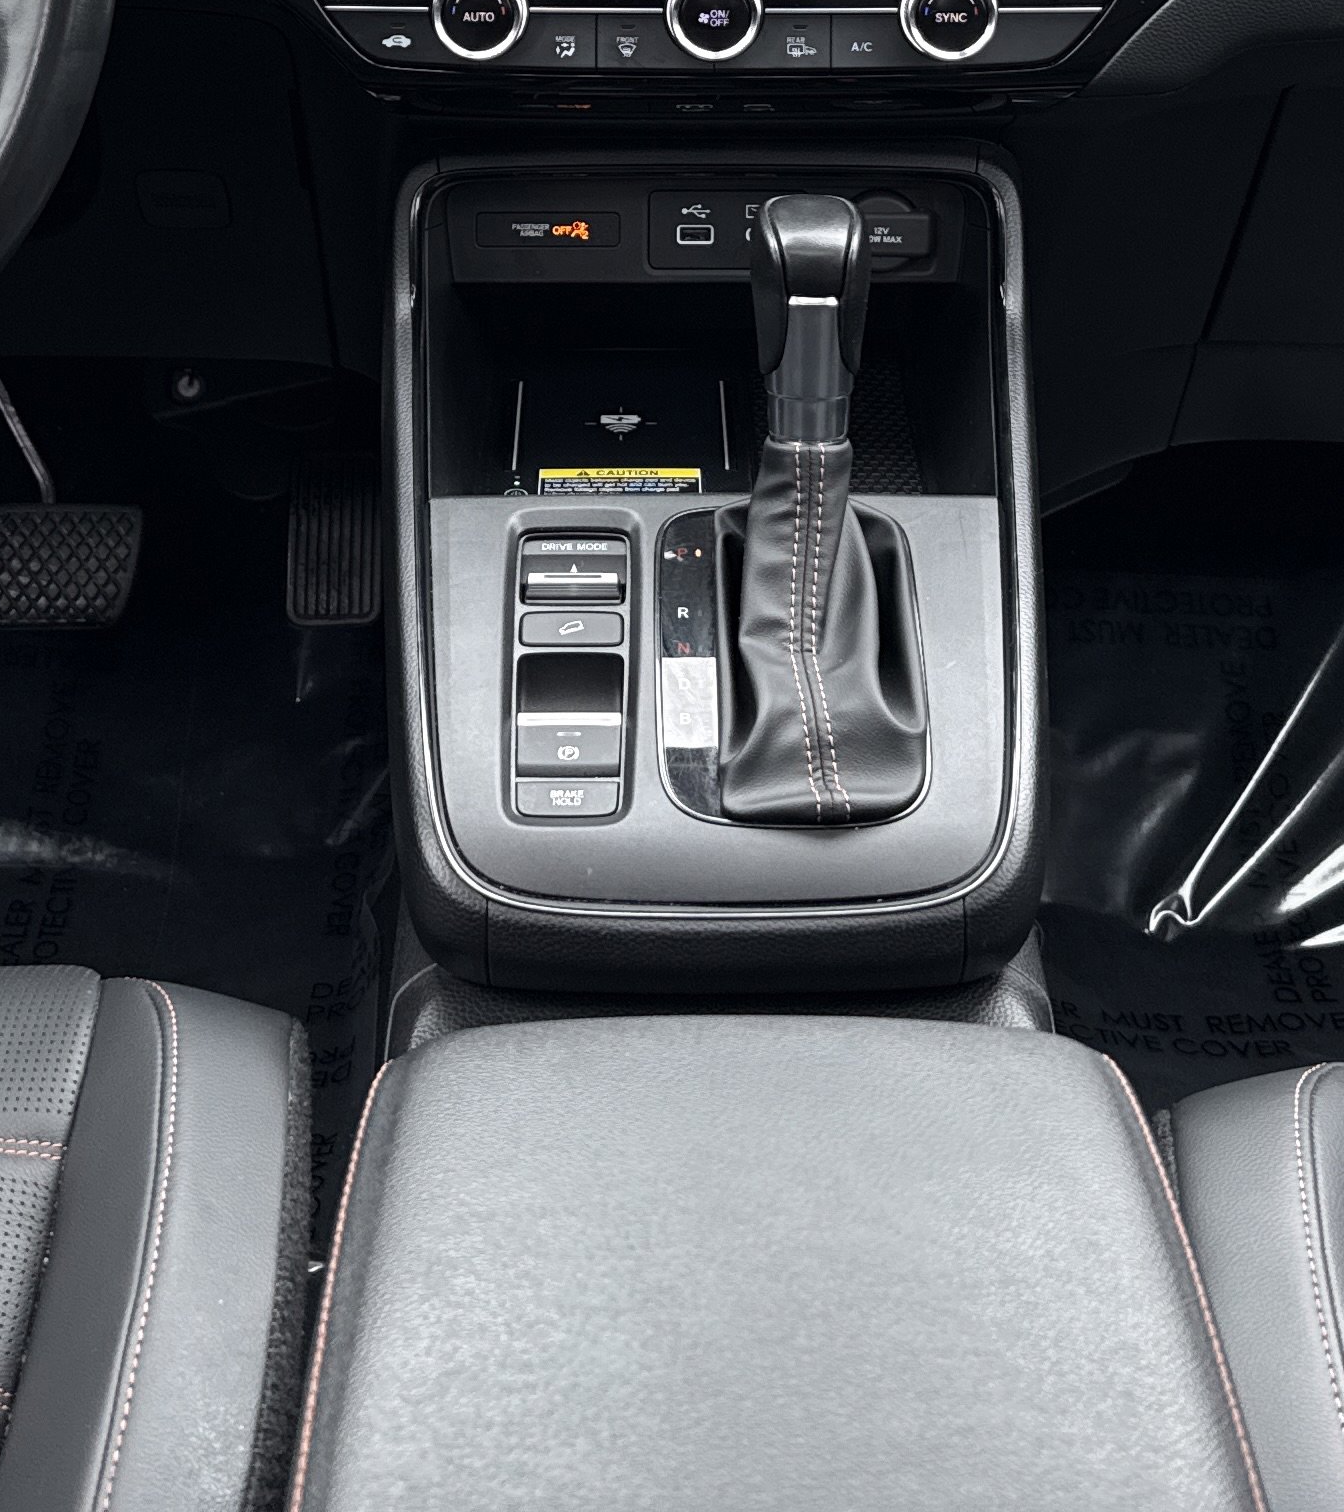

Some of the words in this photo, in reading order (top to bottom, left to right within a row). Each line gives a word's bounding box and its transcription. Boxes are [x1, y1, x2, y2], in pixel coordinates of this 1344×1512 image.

[462, 11, 496, 23] AUTO
[709, 9, 730, 20] ON/
[934, 12, 968, 23] SYNC
[710, 18, 730, 27] OFF
[850, 41, 873, 53] A/C
[552, 225, 572, 236] OFF
[873, 227, 890, 235] 12V
[882, 235, 903, 244] MAX
[541, 542, 573, 551] DRIVE
[576, 542, 608, 551] MODE
[677, 606, 689, 619] R
[677, 642, 691, 654] N
[678, 677, 691, 690] D
[679, 712, 692, 725] B
[549, 790, 584, 799] BRAKE
[552, 798, 582, 806] HOLD
[1056, 1018, 1164, 1052] ECTIVE
